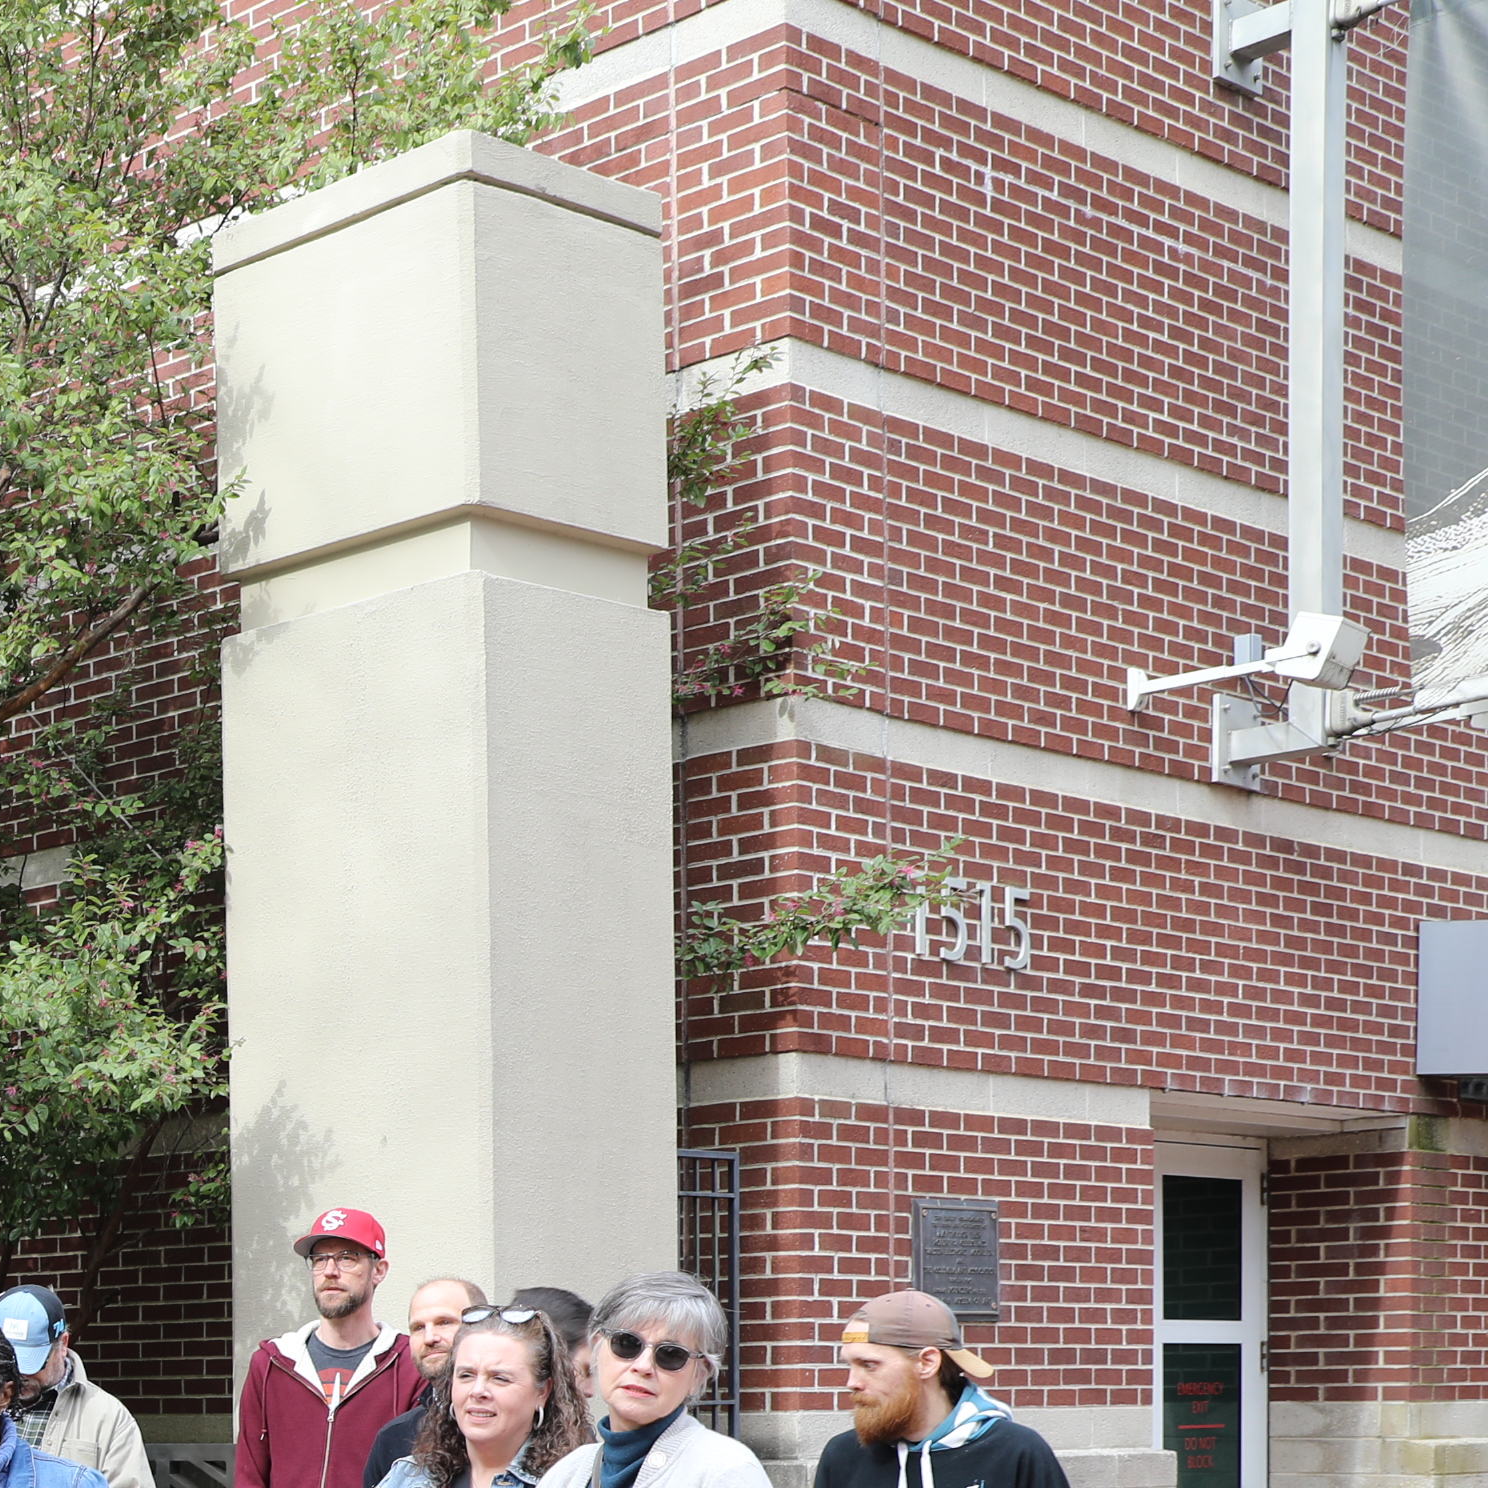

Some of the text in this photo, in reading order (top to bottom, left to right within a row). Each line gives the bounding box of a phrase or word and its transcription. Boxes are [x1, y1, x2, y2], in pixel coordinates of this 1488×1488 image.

[912, 876, 1031, 970] 1515
[1177, 1382, 1223, 1395] EMERGENCY
[1192, 1401, 1209, 1414] EXIT
[1185, 1437, 1217, 1450] DO NOT
[1187, 1456, 1214, 1468] BLOCK
